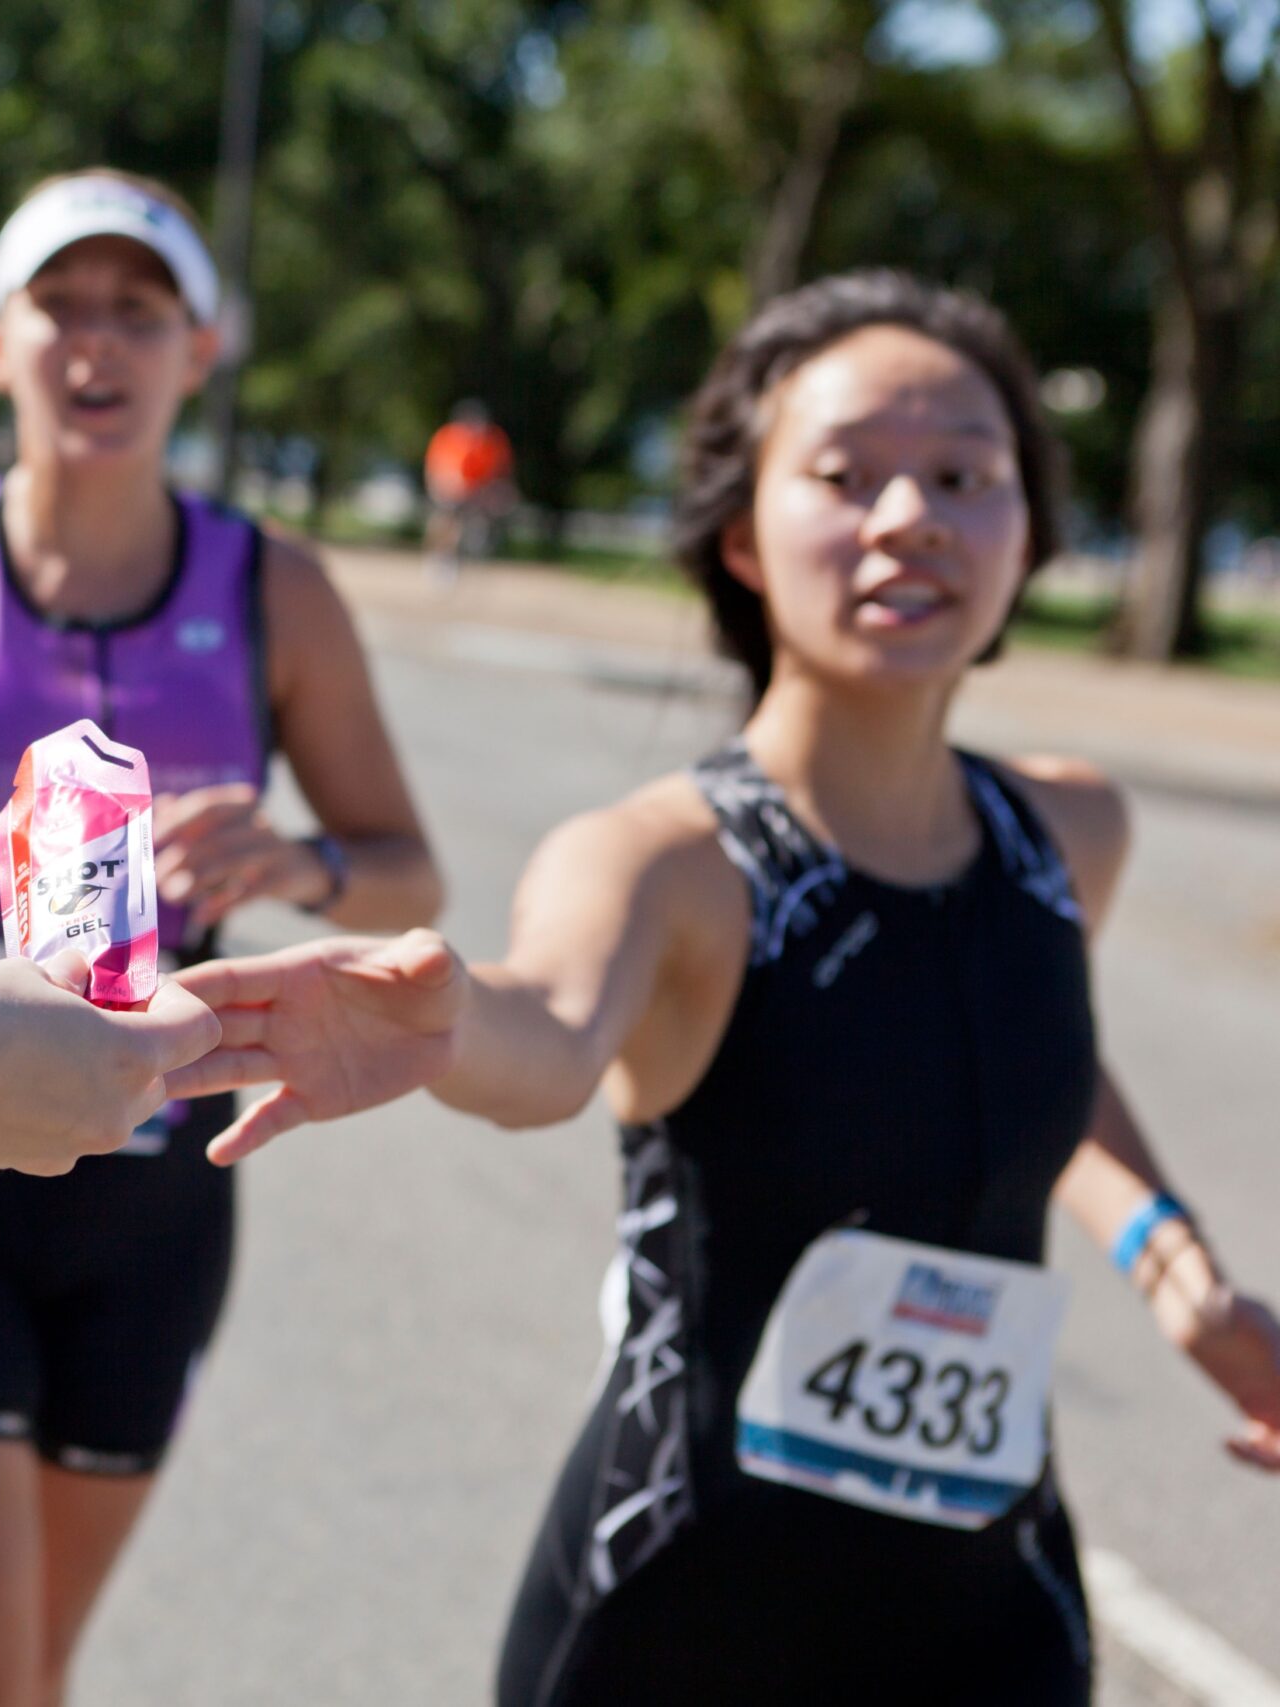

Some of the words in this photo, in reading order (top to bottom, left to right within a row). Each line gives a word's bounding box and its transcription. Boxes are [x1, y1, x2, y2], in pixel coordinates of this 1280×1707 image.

[37, 860, 120, 896] SHOT
[66, 918, 111, 938] GEL
[803, 1337, 1011, 1457] 4333
